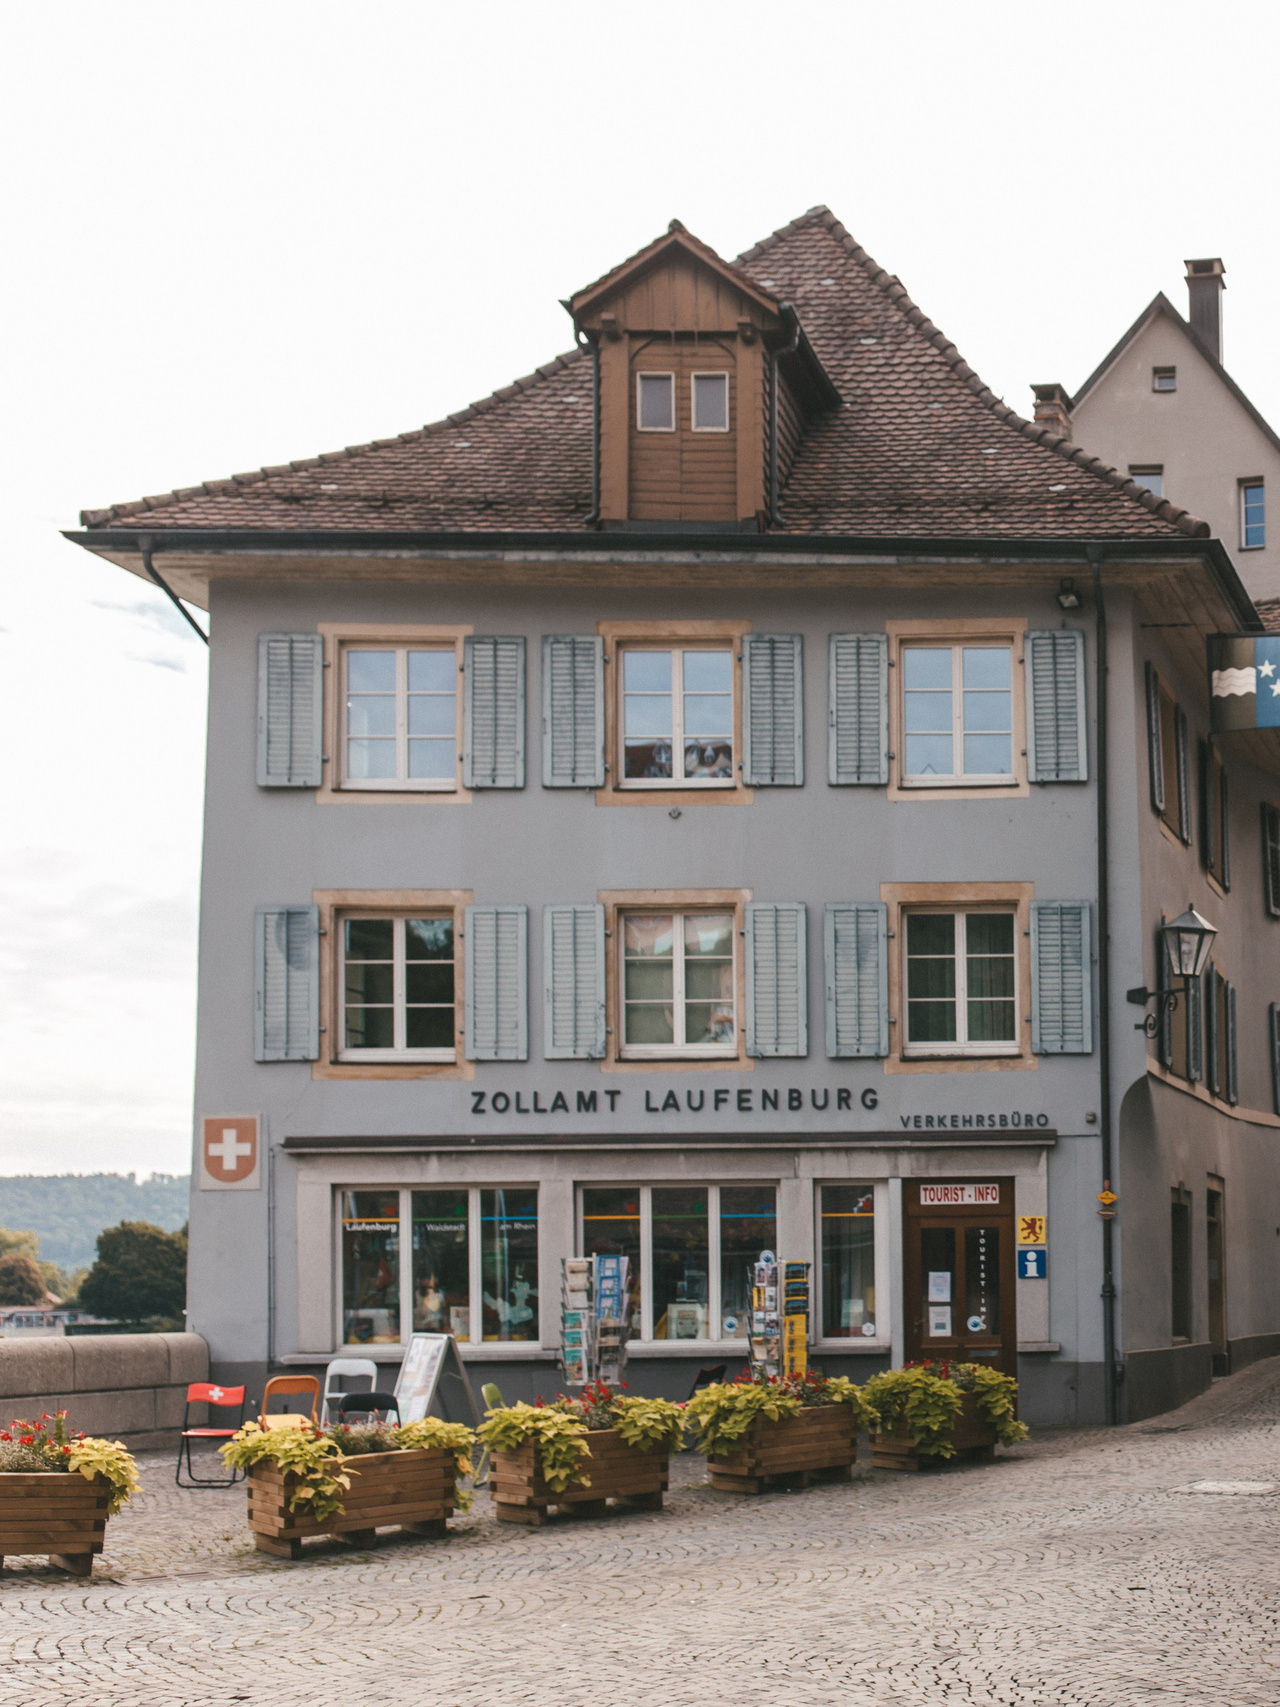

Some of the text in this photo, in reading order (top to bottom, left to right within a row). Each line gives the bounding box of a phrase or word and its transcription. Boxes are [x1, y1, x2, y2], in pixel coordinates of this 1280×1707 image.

[471, 1088, 878, 1114] ZOLLAMT LAUFENBURG
[900, 1112, 1049, 1128] VERKEHRSBÜRO
[922, 1186, 966, 1202] TOURIST
[974, 1186, 998, 1201] INFO
[346, 1222, 397, 1233] Laufenburg
